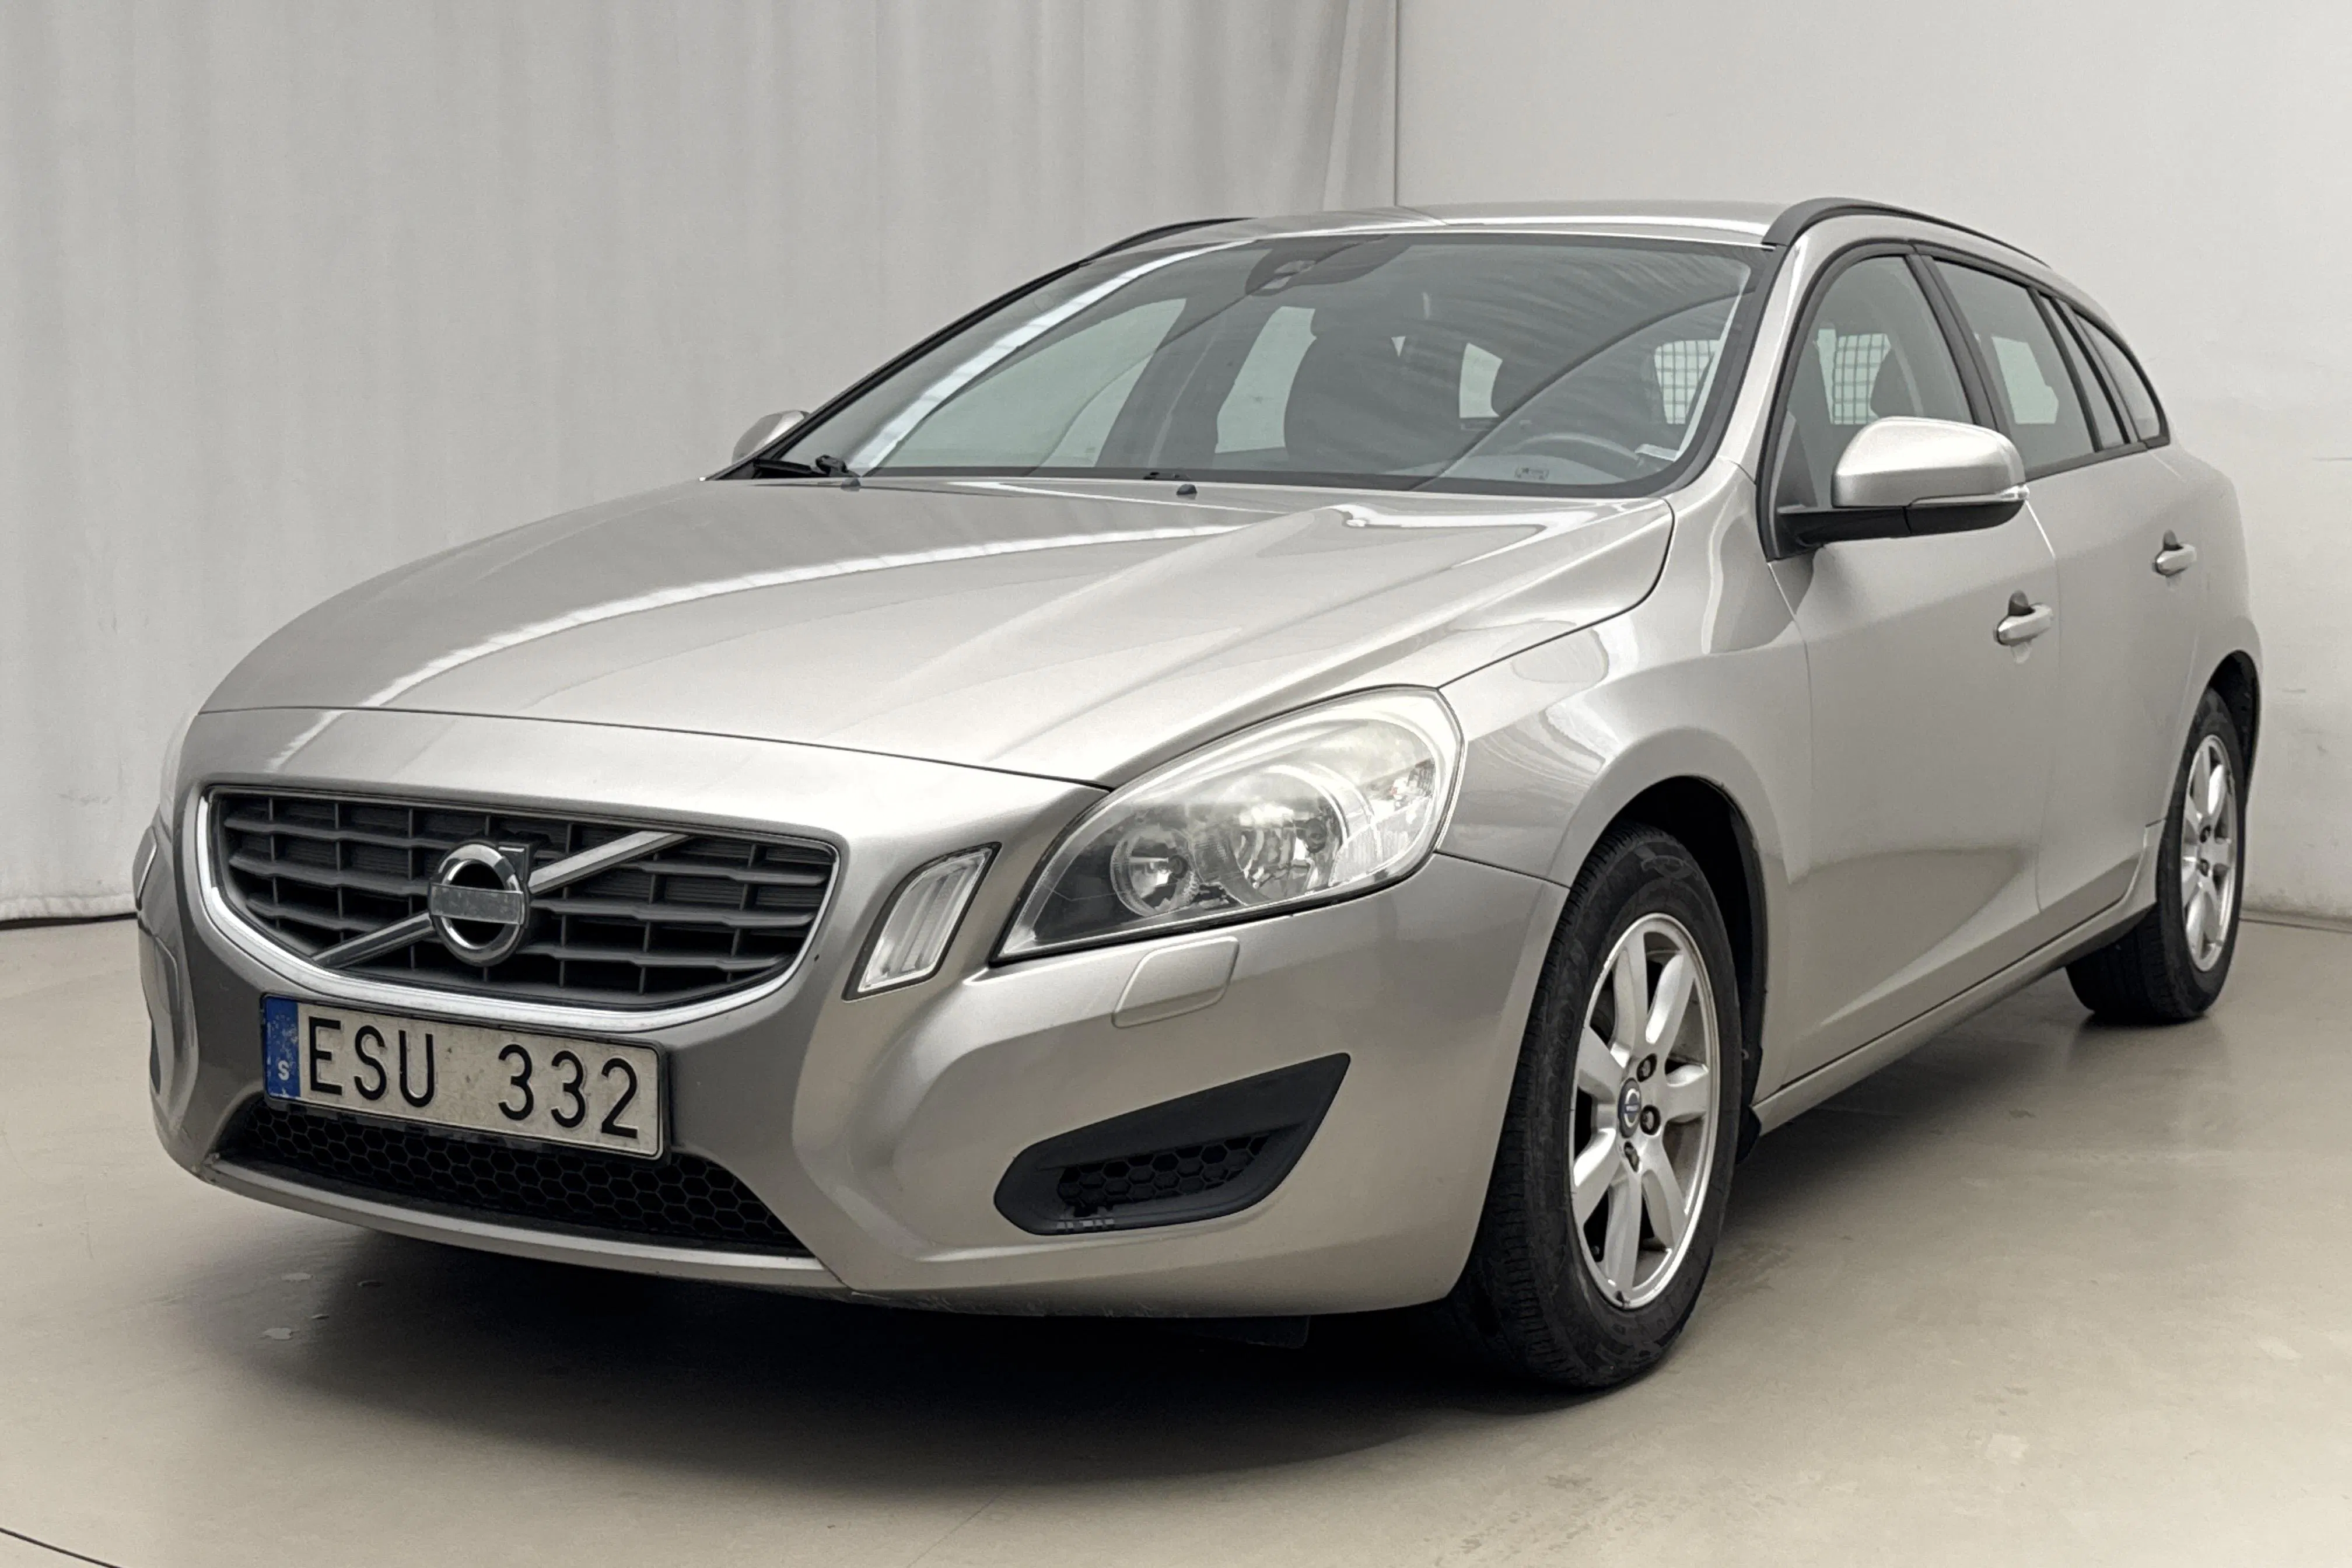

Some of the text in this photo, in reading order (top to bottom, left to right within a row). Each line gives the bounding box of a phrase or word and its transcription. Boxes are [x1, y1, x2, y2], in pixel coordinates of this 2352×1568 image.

[278, 1060, 289, 1080] S
[309, 1016, 638, 1139] ESU 332
